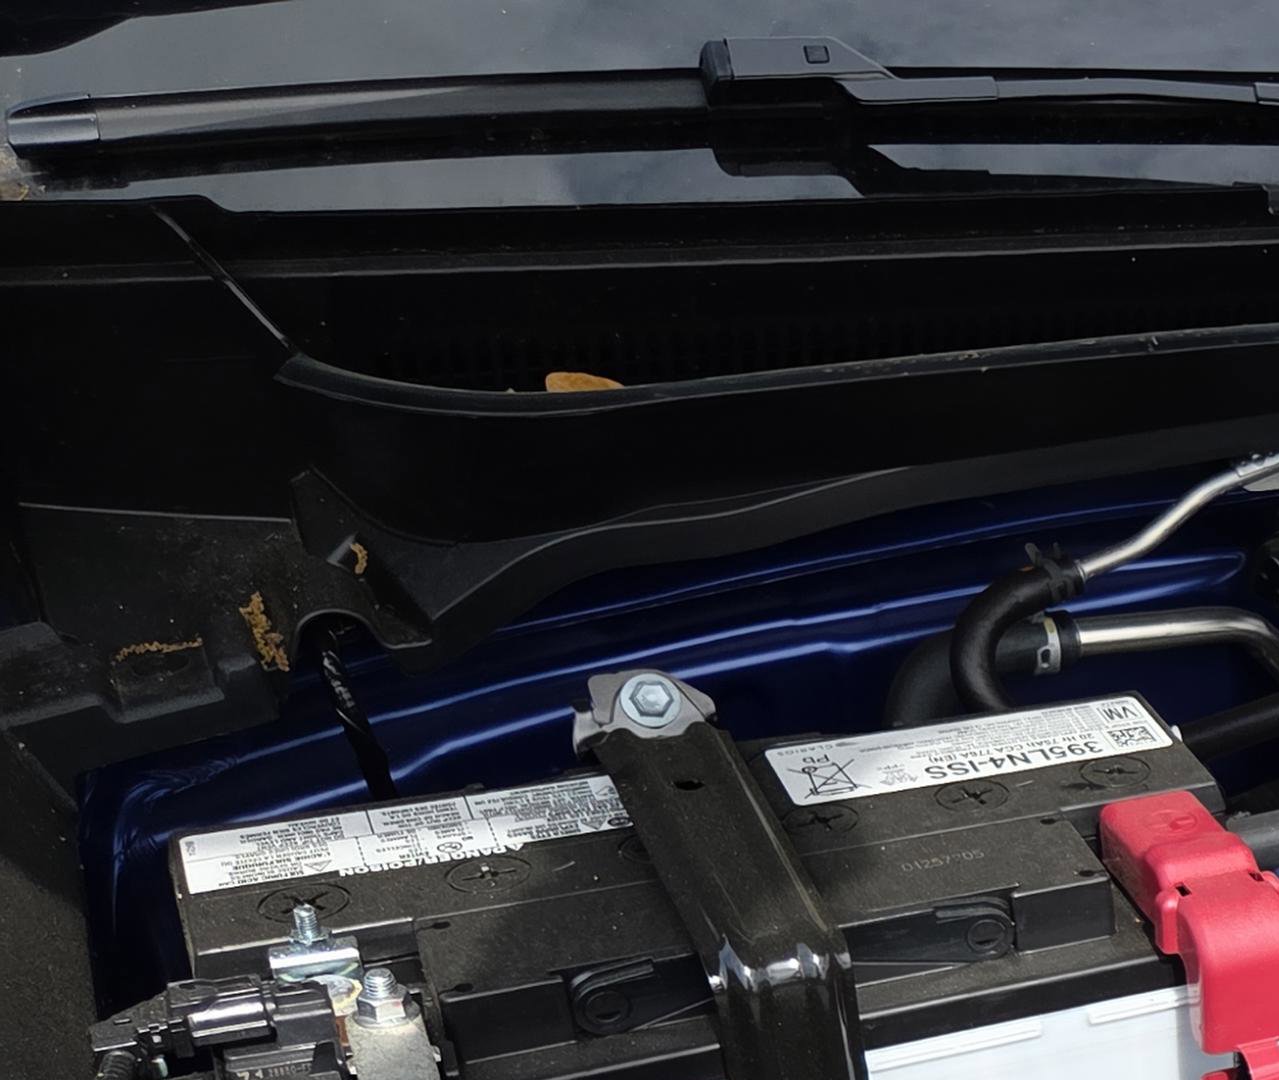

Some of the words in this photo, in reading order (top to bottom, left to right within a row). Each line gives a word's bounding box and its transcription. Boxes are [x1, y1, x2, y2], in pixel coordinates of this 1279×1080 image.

[1100, 704, 1139, 721] VM
[798, 752, 832, 765] Pb
[921, 739, 1104, 780] 395LN4-ISS
[337, 844, 507, 877] DANGER/POISON
